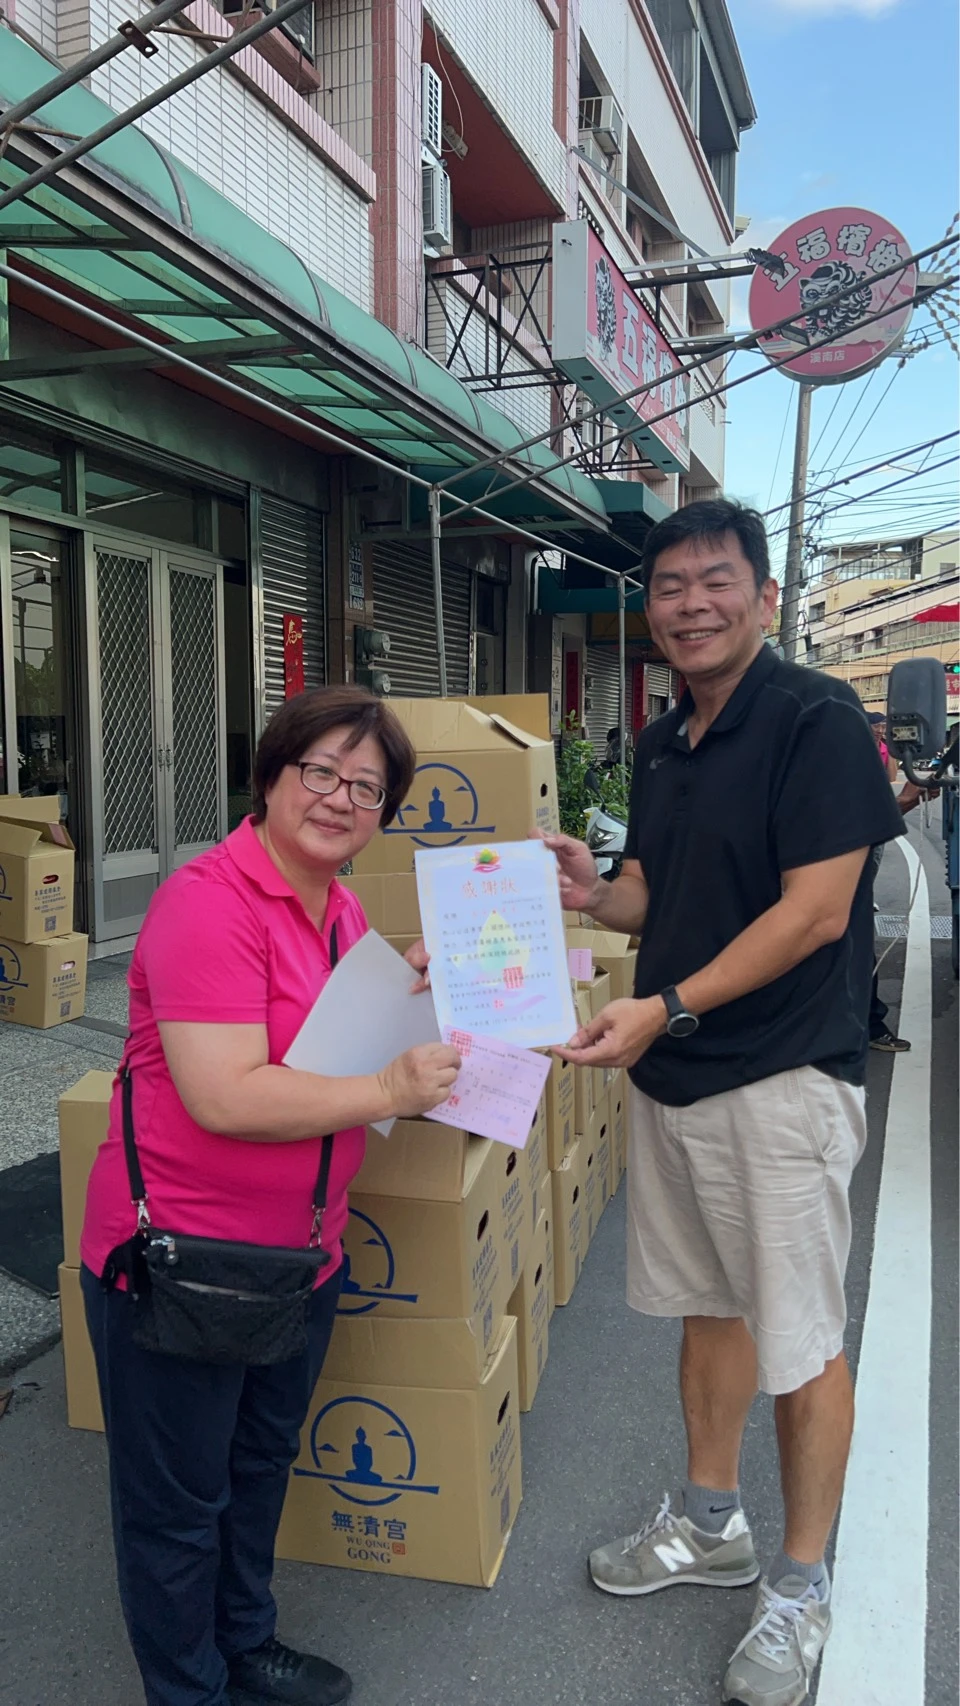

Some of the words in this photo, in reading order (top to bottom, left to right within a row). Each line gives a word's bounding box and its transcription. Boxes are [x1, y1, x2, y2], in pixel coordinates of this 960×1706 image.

[462, 878, 518, 898] 感謝狀
[331, 1510, 407, 1541] 無清宮
[346, 1536, 363, 1546] WU
[365, 1540, 391, 1550] QING
[347, 1547, 392, 1564] GONG
